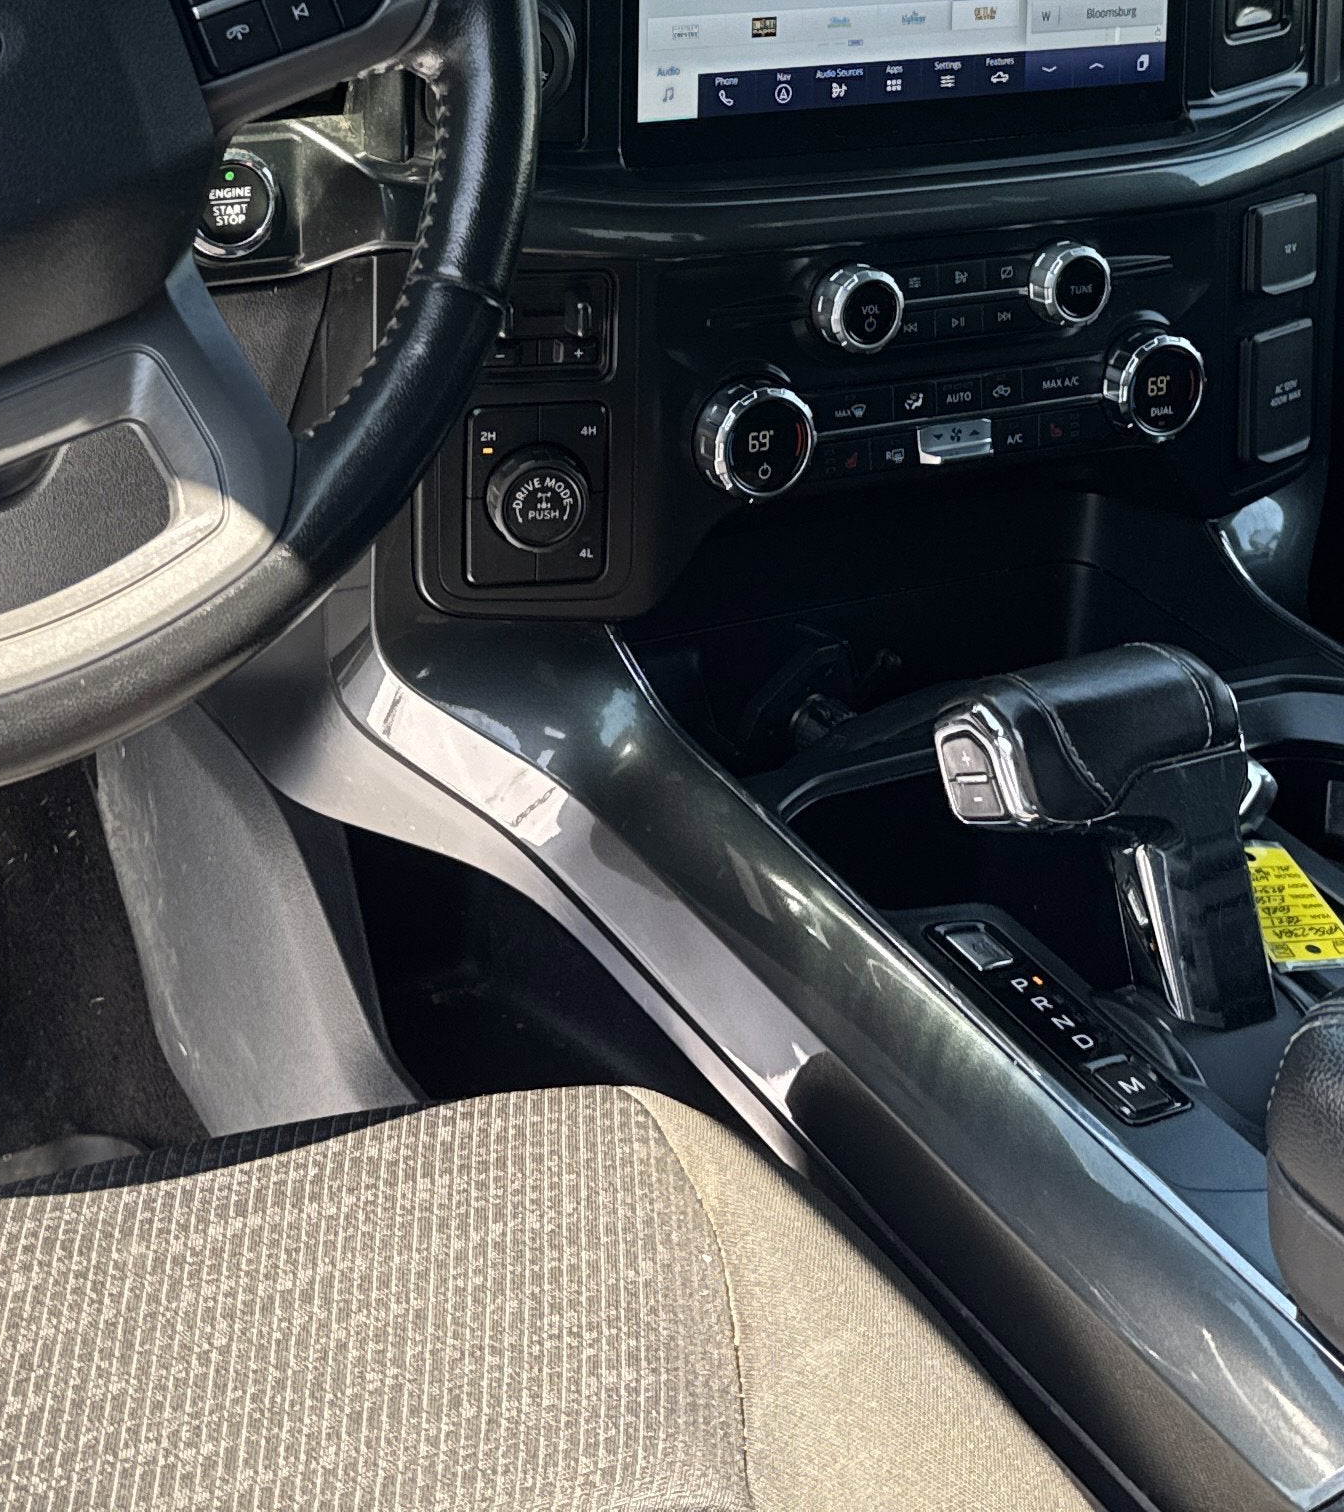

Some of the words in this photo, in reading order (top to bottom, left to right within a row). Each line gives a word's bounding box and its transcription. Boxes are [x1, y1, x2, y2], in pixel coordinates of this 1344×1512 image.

[1042, 11, 1051, 22] W
[1086, 7, 1137, 20] Bloomsburg
[934, 61, 962, 71] Settings
[985, 56, 1015, 67] Features
[657, 66, 681, 77] Audio
[816, 69, 836, 79] Audio
[837, 67, 864, 77] Sources
[886, 64, 903, 75] Apps
[715, 76, 738, 86] Phone
[777, 72, 792, 82] Nav
[208, 185, 252, 199] ENGINE
[212, 202, 248, 218] START
[215, 213, 247, 227] STOP
[861, 304, 880, 316] VOL
[1042, 378, 1062, 389] MAX
[1064, 376, 1080, 387] A/C
[946, 391, 972, 403] AUTO
[1150, 405, 1173, 417] DUAL
[480, 431, 497, 443] 2H
[580, 425, 597, 437] 4H
[1006, 432, 1024, 445] A/C
[513, 476, 542, 511] DRIVE
[544, 476, 575, 506] MODE
[528, 508, 560, 521] PUSH
[579, 547, 594, 560] 4L
[1010, 978, 1029, 993] P
[1030, 996, 1054, 1012] R
[1051, 1014, 1076, 1030] N
[1071, 1034, 1094, 1050] D
[1118, 1076, 1147, 1094] M
